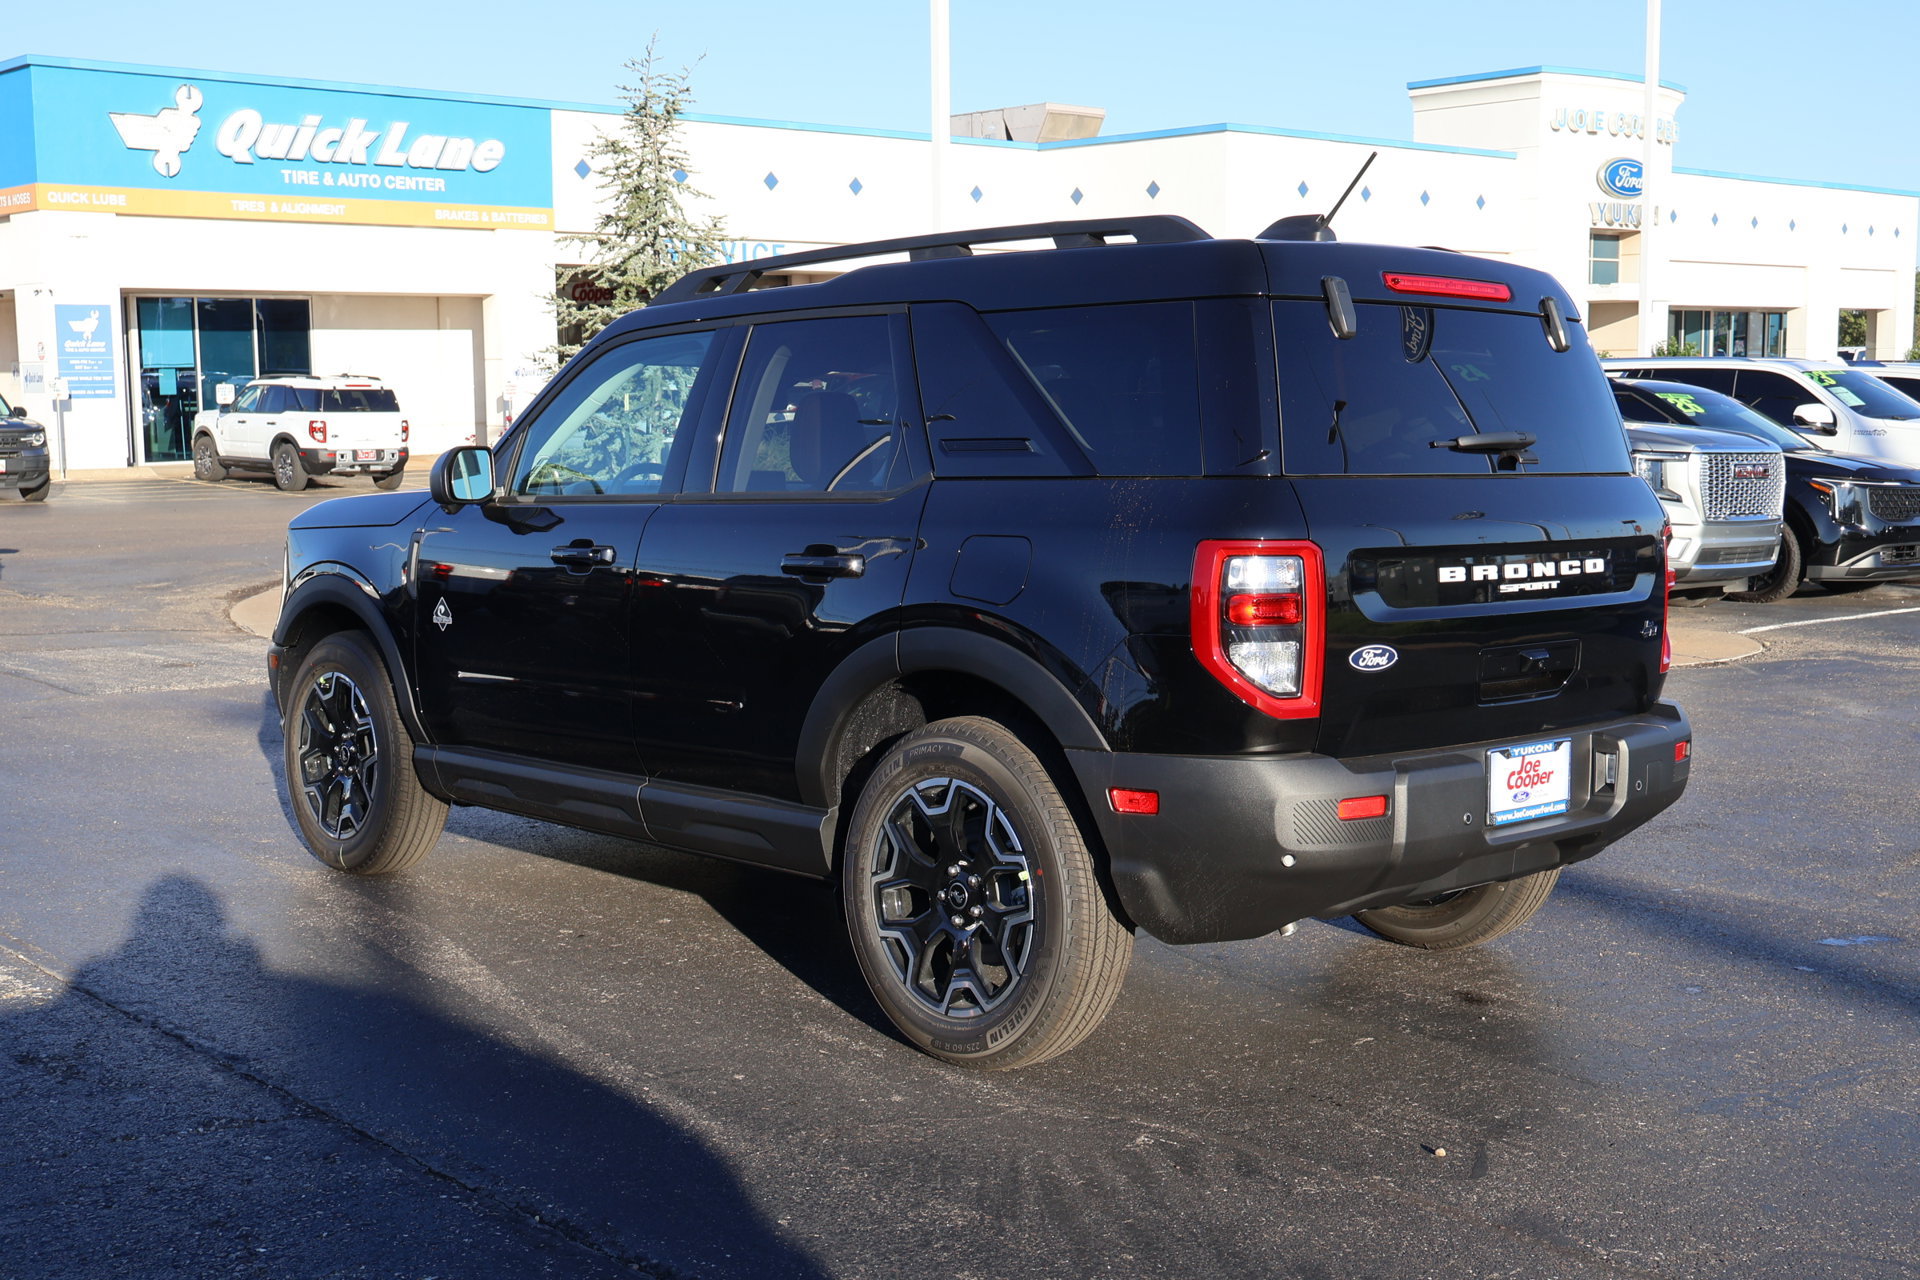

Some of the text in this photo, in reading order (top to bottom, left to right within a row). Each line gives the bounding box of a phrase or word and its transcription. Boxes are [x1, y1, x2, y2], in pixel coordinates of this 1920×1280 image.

[1552, 107, 1605, 134] JOE
[215, 108, 505, 172] Quick Lane
[281, 169, 446, 192] TIRE & AUTO CENTER
[47, 191, 127, 206] QUICK LUBE
[230, 199, 346, 216] TIRES & ALIGNMENT
[435, 208, 548, 224] BRAKES & BATTERIES
[1438, 558, 1605, 583] BRONCO
[1498, 580, 1561, 593] SPORT
[1357, 649, 1390, 667] Ford
[909, 744, 944, 758] PRIMACY
[1513, 743, 1553, 756] YUKON
[1517, 755, 1541, 776] Joe
[1507, 770, 1554, 790] Cooper
[989, 984, 1039, 1044] MICHELIN
